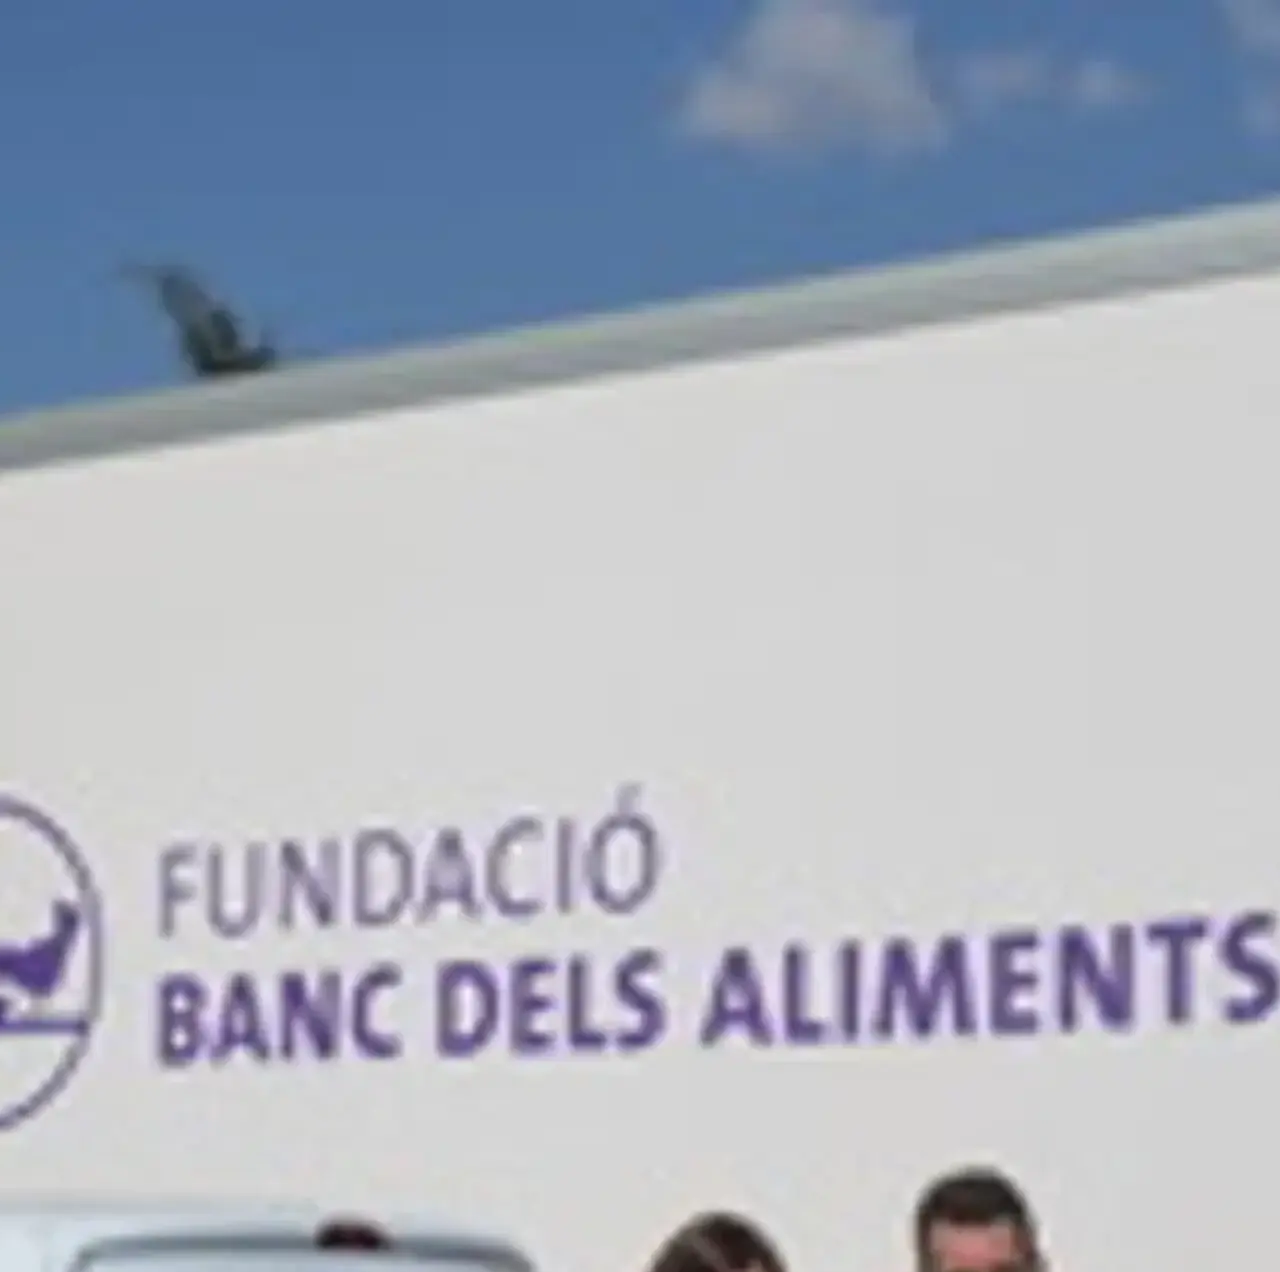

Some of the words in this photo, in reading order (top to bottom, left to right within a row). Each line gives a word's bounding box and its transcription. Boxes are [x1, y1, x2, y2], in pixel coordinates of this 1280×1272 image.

[156, 784, 663, 942] FUNDACIÓ
[156, 962, 402, 1069] BANC
[435, 947, 667, 1060] DELS
